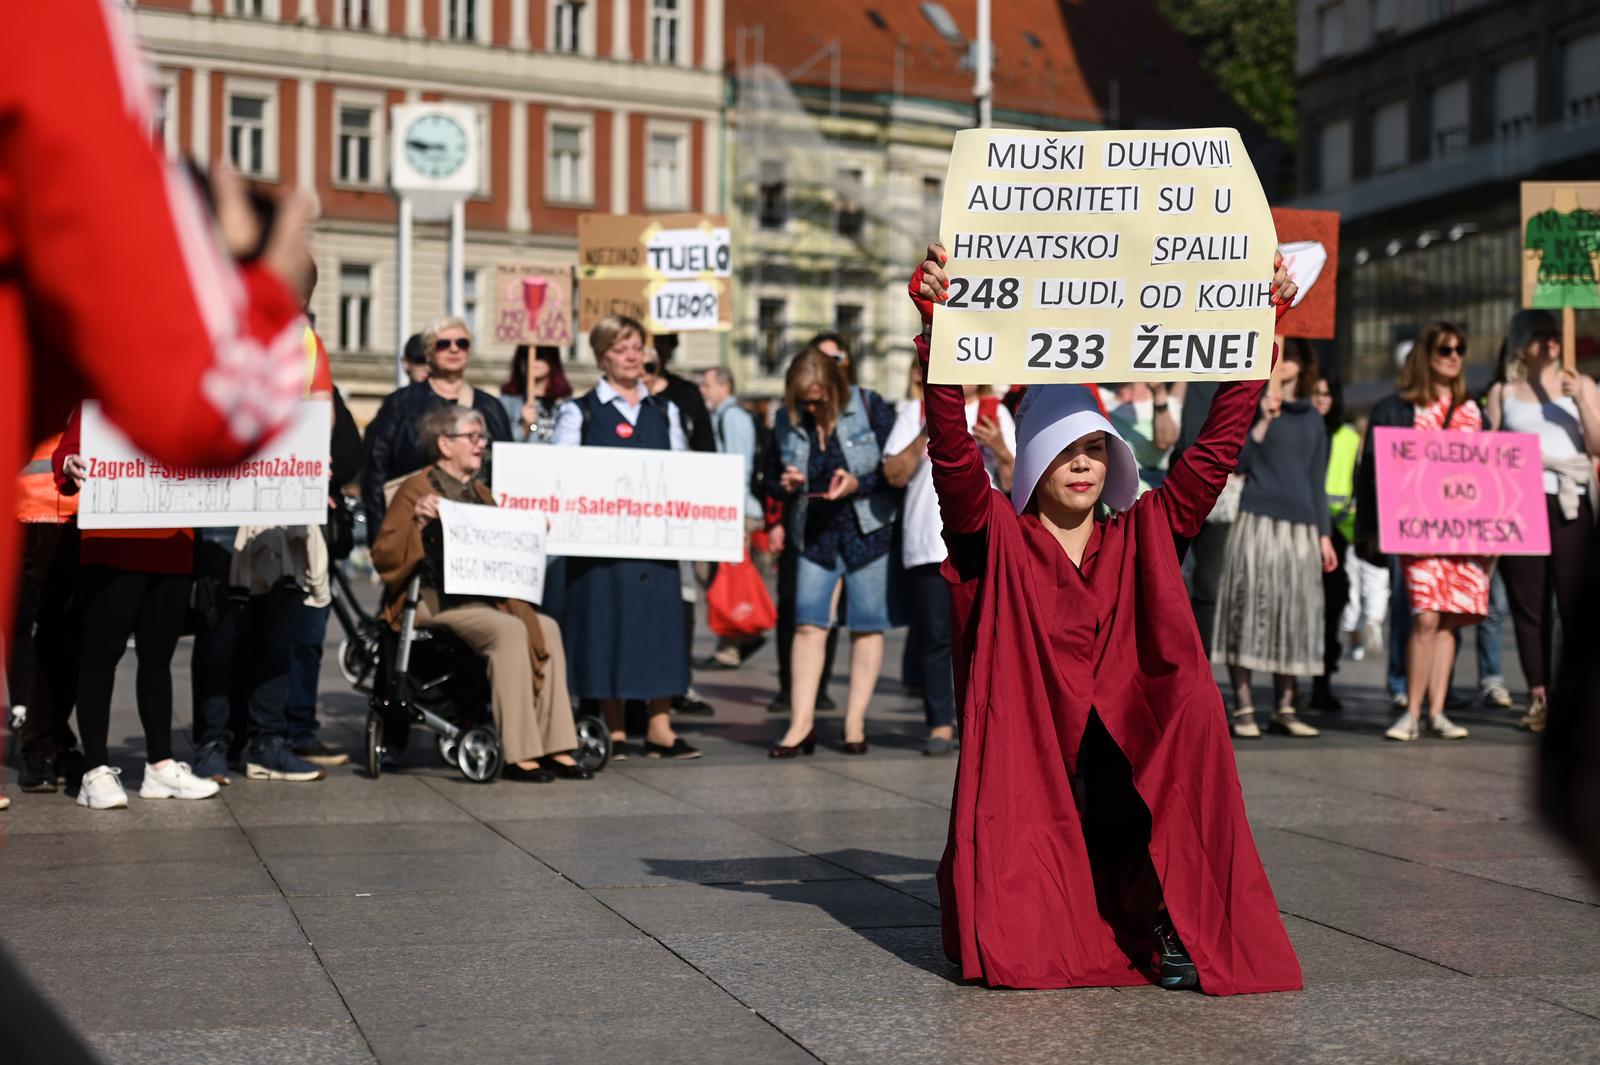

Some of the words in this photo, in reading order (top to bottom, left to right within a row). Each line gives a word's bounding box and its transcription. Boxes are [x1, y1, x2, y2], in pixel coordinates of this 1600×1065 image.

[987, 138, 1085, 170] MUŠKI
[1107, 139, 1232, 168] DUHOVNI
[967, 185, 1139, 211] AUTORITETI
[1158, 187, 1194, 212] SU
[1215, 188, 1232, 213] U
[649, 244, 731, 271] TIJELO
[953, 234, 1120, 259] HRVATSKOJ
[1154, 235, 1249, 262] SPALILI
[655, 295, 717, 318] IZBOR
[946, 277, 1020, 310] 248
[1040, 281, 1125, 308] LJUDI,
[1139, 285, 1182, 309] OD
[1198, 283, 1272, 308] KOJIH
[956, 336, 993, 361] SU
[1028, 332, 1105, 369] 233
[1133, 325, 1258, 369] ŽENE!
[89, 457, 145, 480] Zagreb
[1392, 442, 1416, 461] NE
[1497, 447, 1522, 470] ME
[499, 493, 560, 513] Zagreb
[565, 496, 739, 522] #SafePlace4Women
